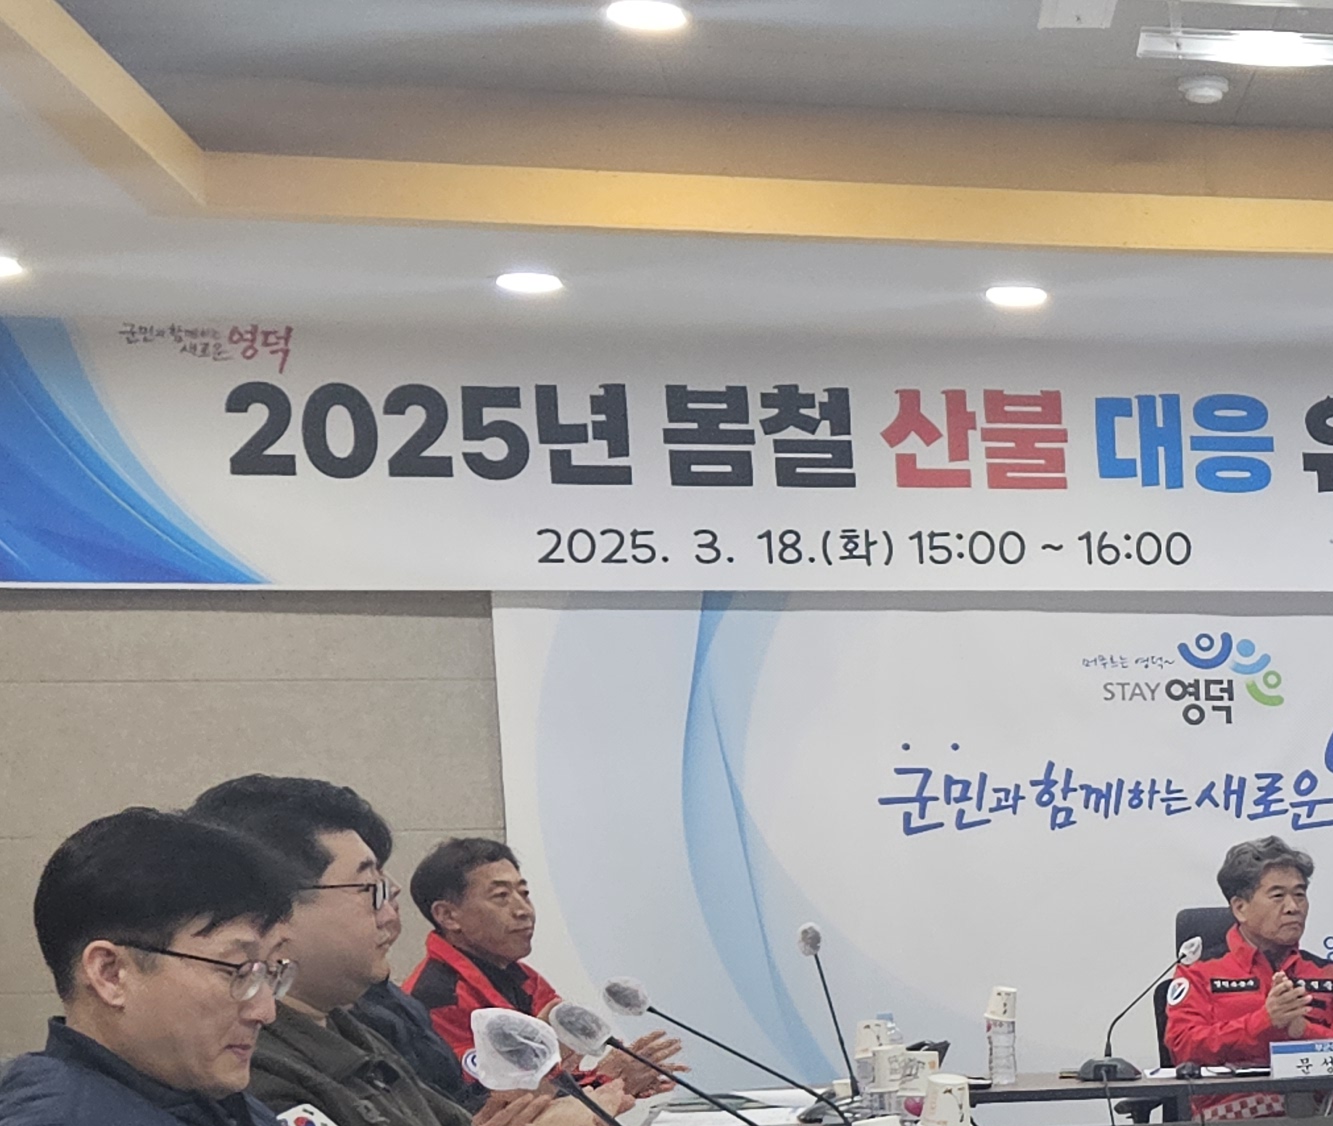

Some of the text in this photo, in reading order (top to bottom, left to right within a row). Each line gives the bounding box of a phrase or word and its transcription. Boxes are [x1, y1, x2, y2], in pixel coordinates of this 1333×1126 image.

[228, 324, 293, 374] 영덕
[224, 380, 634, 487] 2025년
[661, 382, 858, 489] 봄철
[880, 387, 1068, 489] 산불
[1094, 391, 1276, 495] 대응
[536, 528, 669, 565] 2025.
[693, 529, 735, 565] 3.
[757, 528, 895, 568] 18.(화)
[908, 530, 1026, 565] 15:00
[1077, 531, 1192, 566] 16:00
[1103, 678, 1235, 725] STAY 영덕
[878, 767, 1025, 836] 군민과
[1028, 760, 1193, 831] 함께하는
